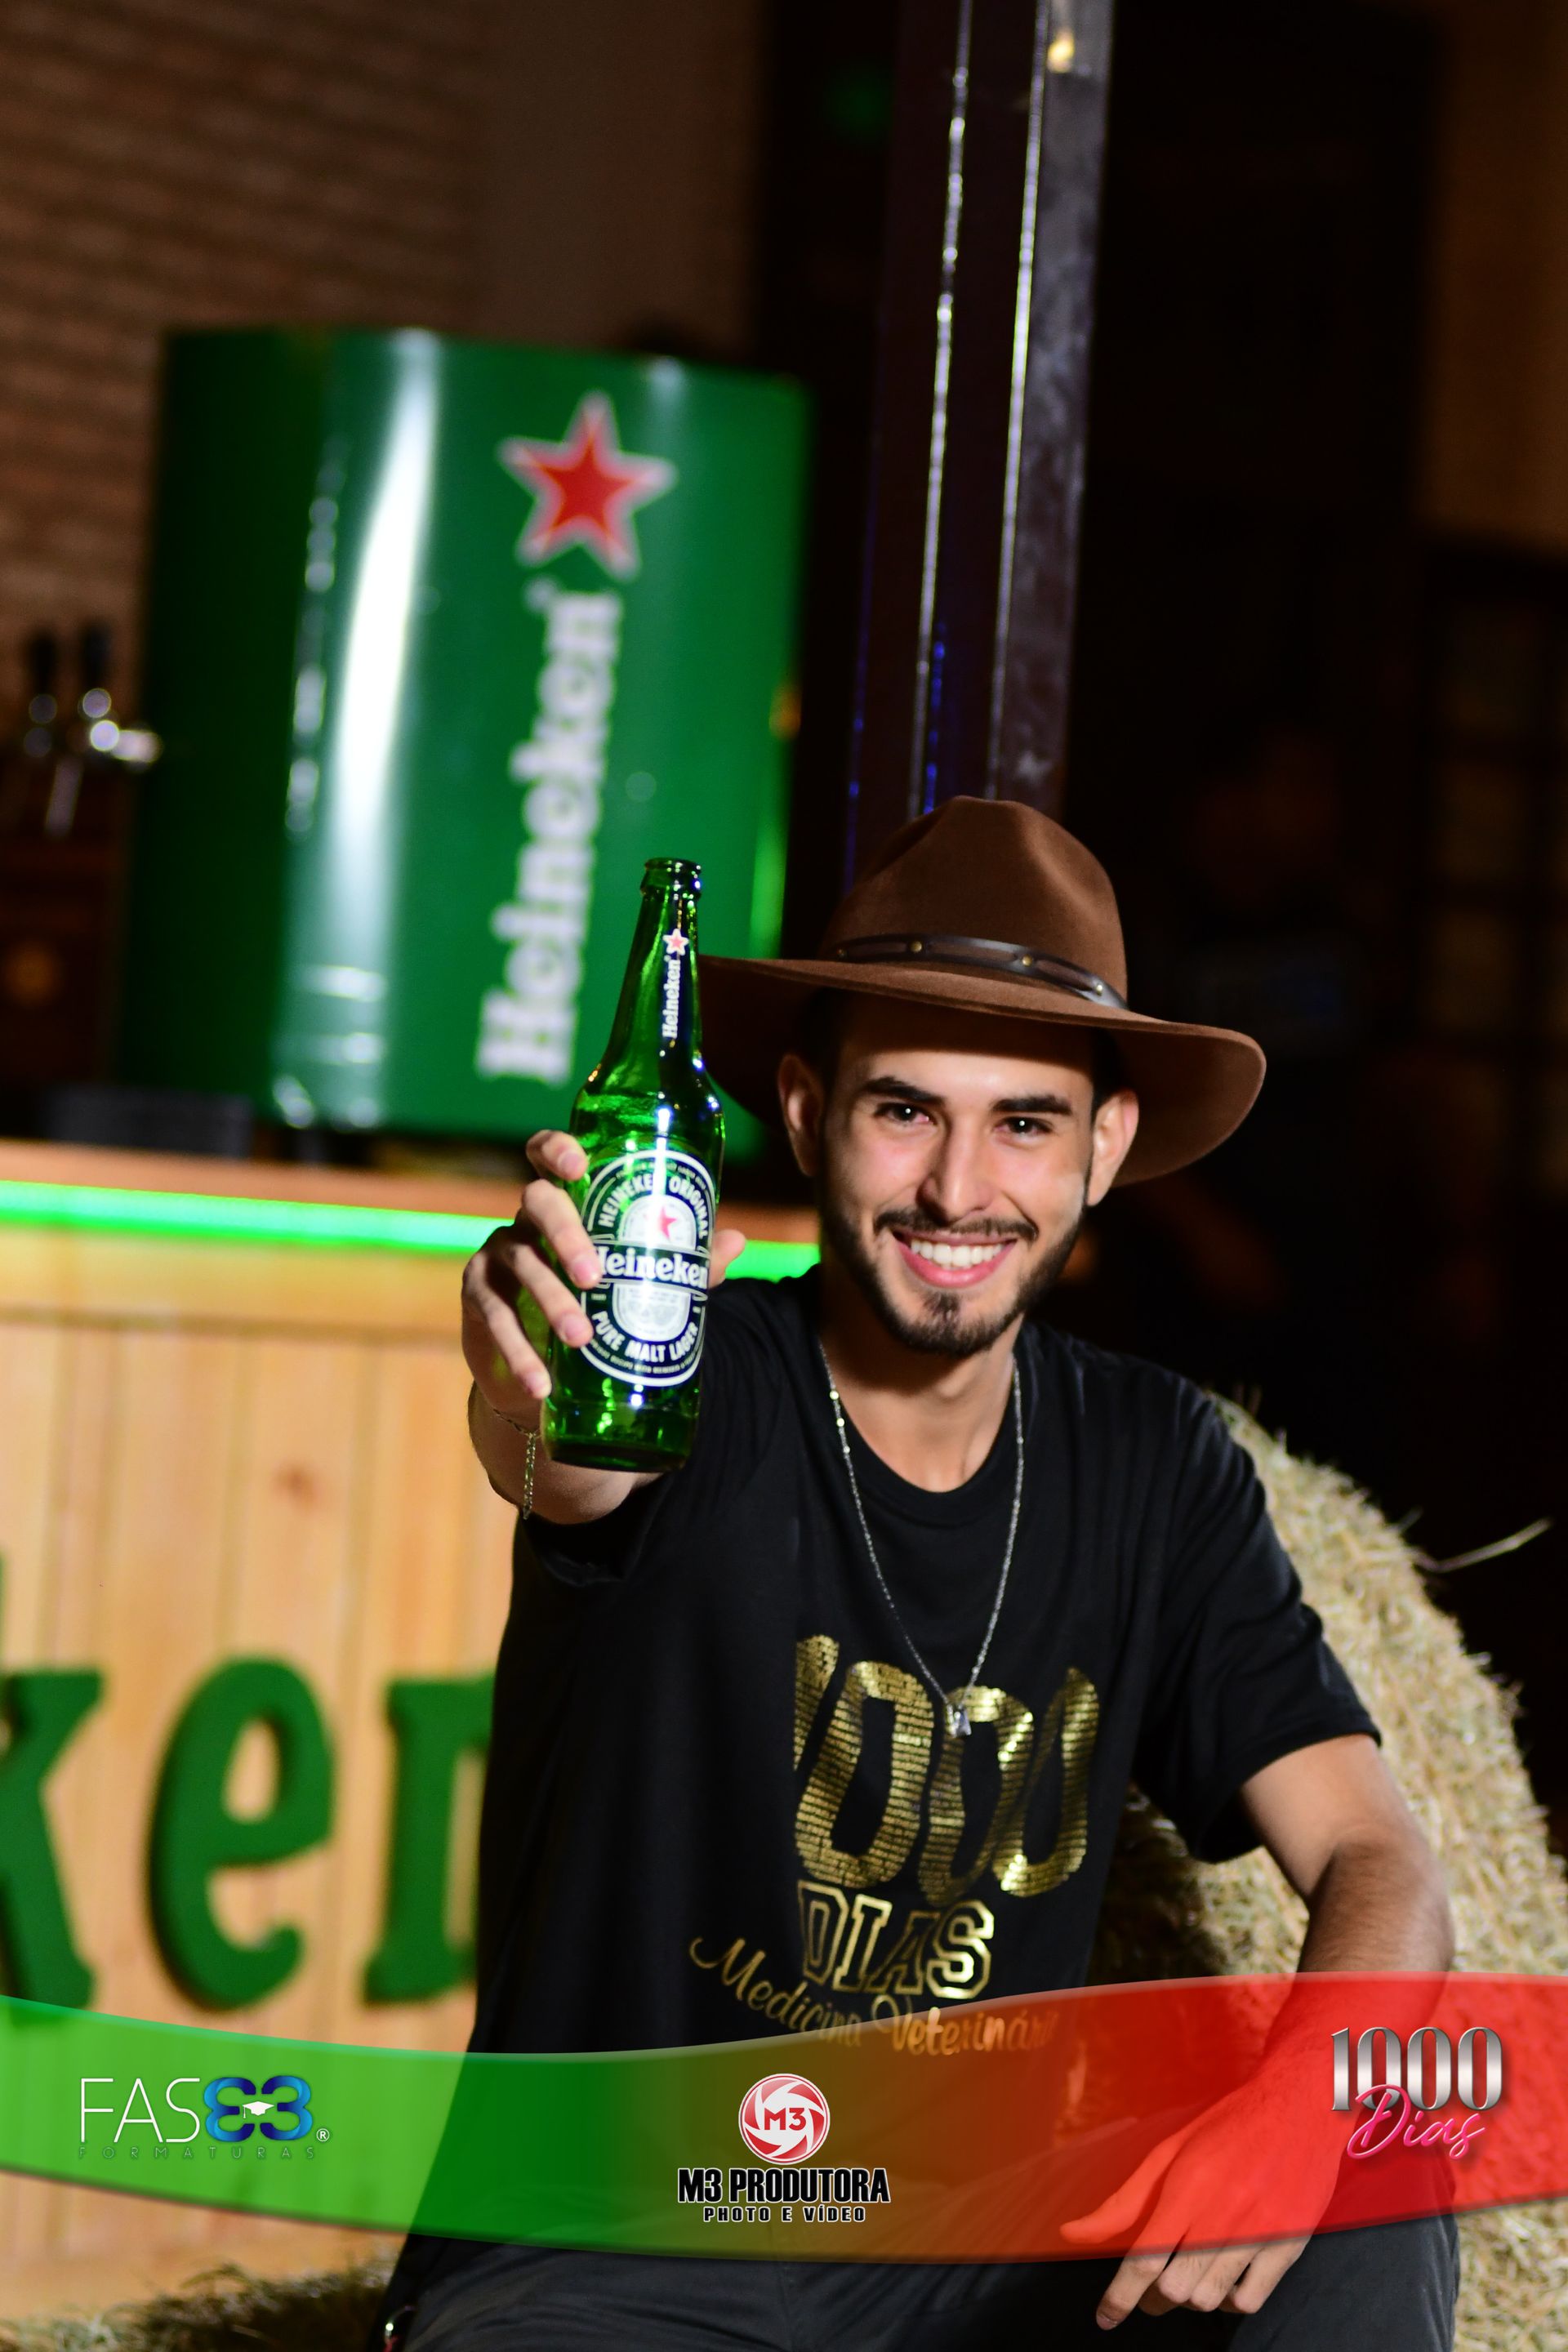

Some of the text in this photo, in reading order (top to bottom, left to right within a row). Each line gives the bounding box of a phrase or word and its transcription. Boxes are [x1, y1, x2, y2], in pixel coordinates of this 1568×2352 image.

[476, 592, 622, 1085] Heineken
[662, 959, 681, 1039] Heineken
[598, 1173, 666, 1228] HEINEKE
[669, 1175, 708, 1240] ORIGINAL
[591, 1311, 626, 1351] PURE
[625, 1340, 666, 1362] MALT
[669, 1321, 698, 1361] LAGER
[797, 1880, 995, 1999] DIAS
